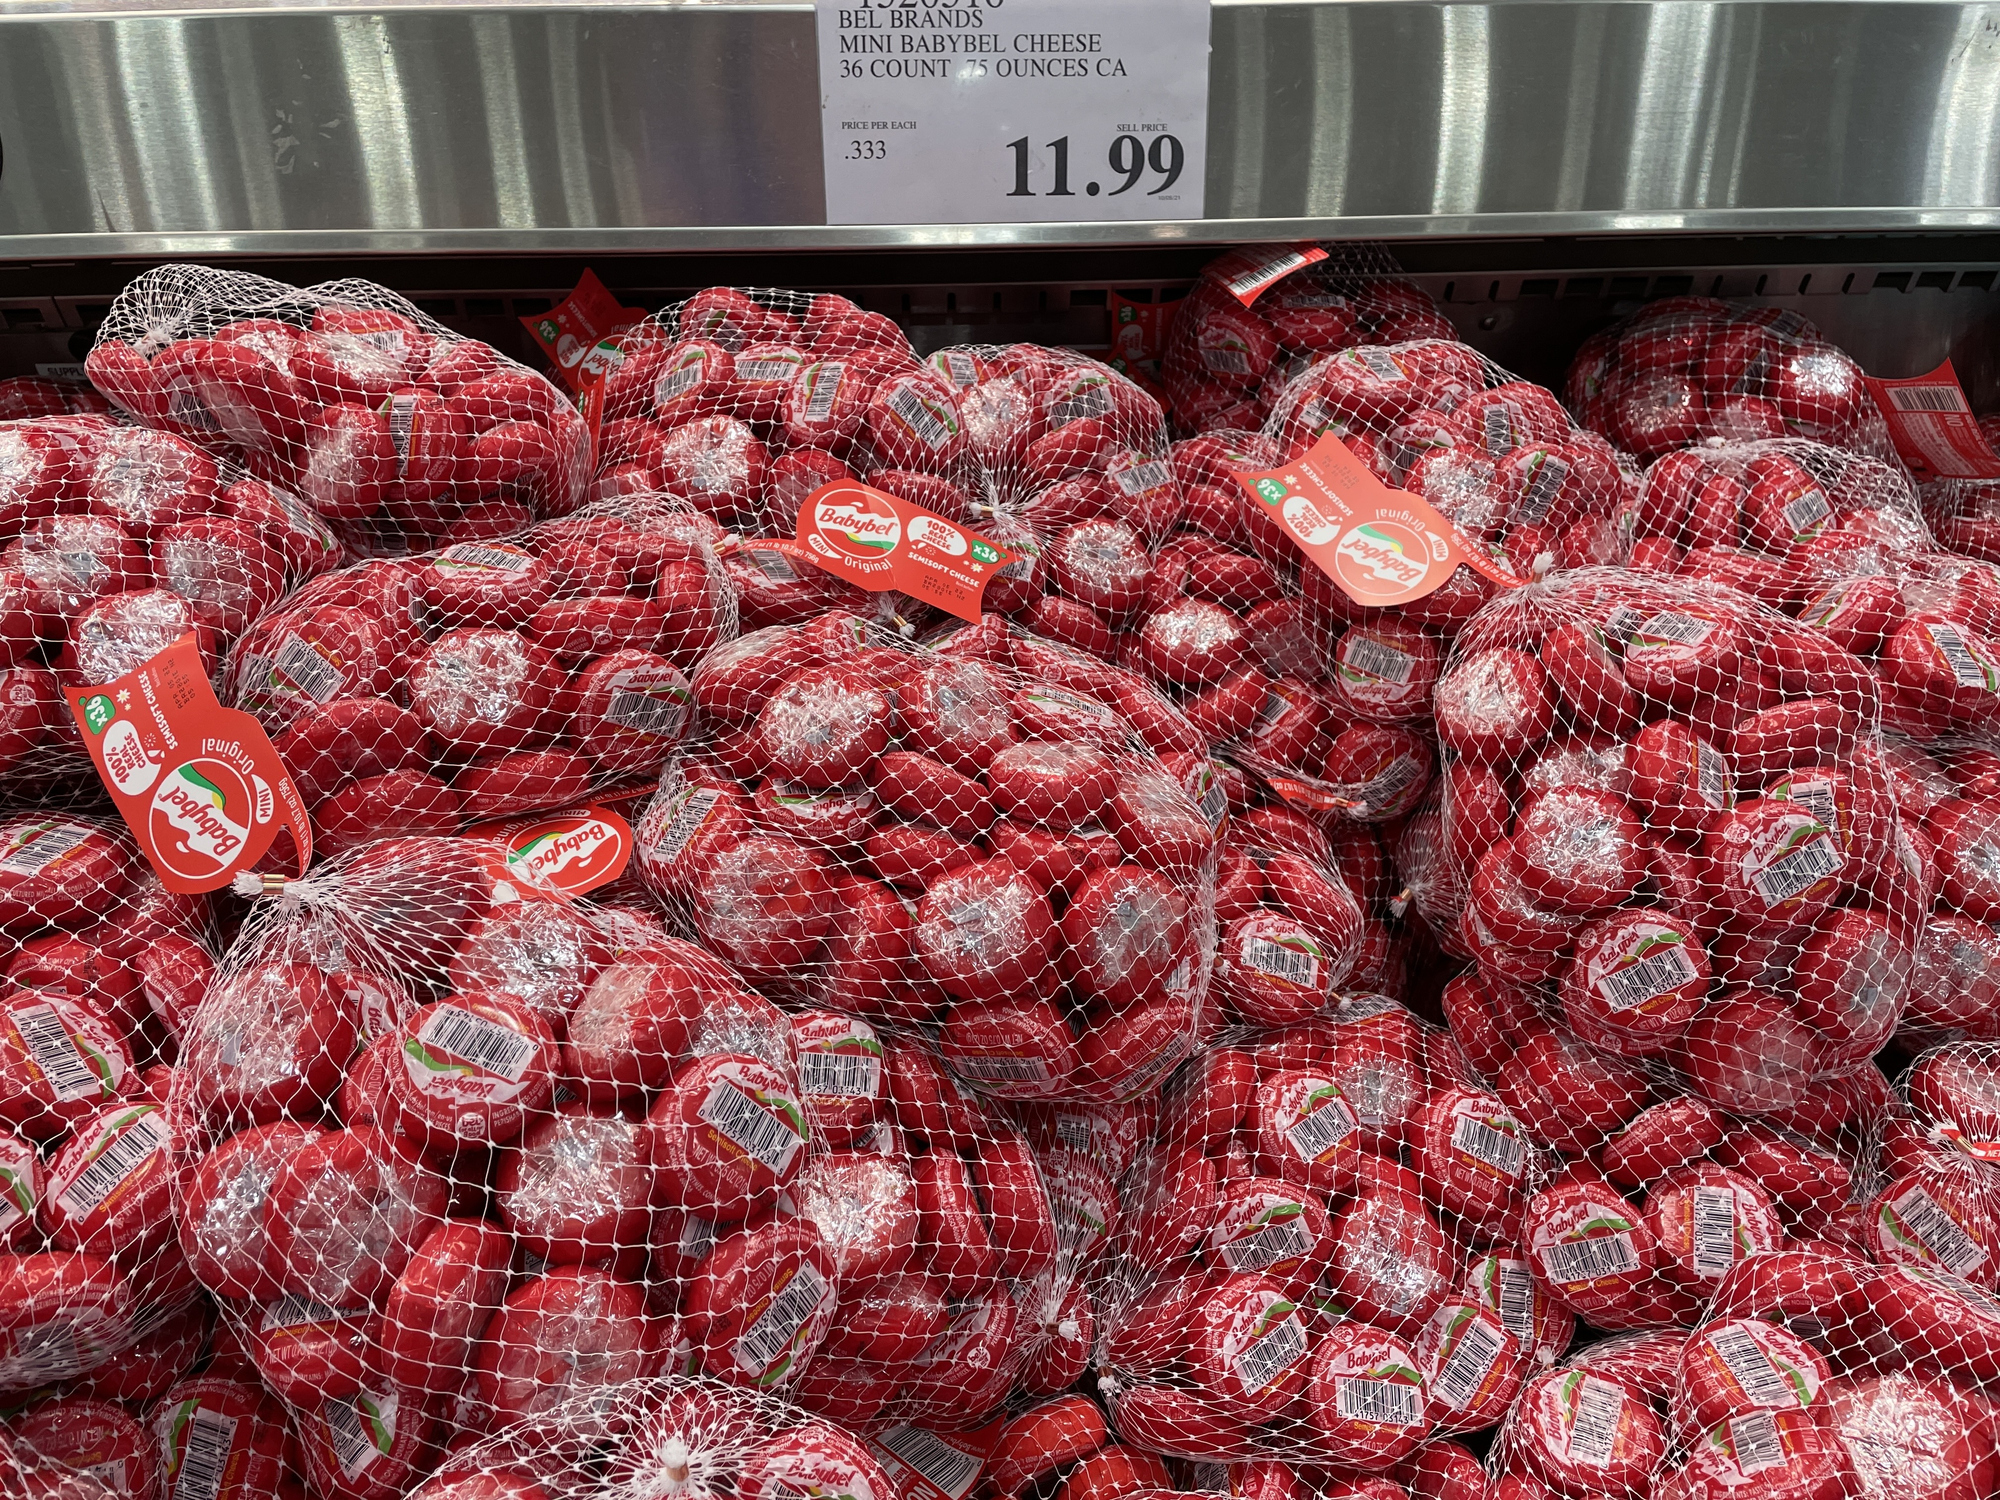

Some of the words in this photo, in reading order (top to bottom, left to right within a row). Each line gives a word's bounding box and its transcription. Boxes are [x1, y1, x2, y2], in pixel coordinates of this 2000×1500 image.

[839, 10, 882, 29] BEL
[890, 10, 983, 29] BRANDS
[840, 35, 891, 53] MINI
[900, 34, 1006, 53] BABYBEL
[1014, 34, 1102, 53] CHEESE
[841, 59, 863, 78] 36
[870, 59, 951, 78] COUNT
[996, 58, 1088, 77] OUNCES
[1096, 58, 1127, 77] CA
[841, 121, 868, 130] PRICE
[871, 122, 888, 130] PER
[891, 121, 917, 130] EACH
[1117, 124, 1138, 132] SELL
[1141, 123, 1167, 131] PRICE
[845, 140, 886, 160] .333
[1006, 134, 1184, 197] 11.99
[539, 321, 556, 341] x36
[47, 367, 84, 376] SUPPL
[1944, 414, 1964, 427] NO
[1299, 462, 1324, 487] CHEESE
[1258, 479, 1281, 500] x36
[1321, 485, 1354, 516] SEMISOFT
[818, 507, 895, 536] Babybel
[1287, 513, 1313, 537] 100%
[1300, 512, 1317, 529] REAL
[1302, 504, 1326, 528] CHEESE
[1375, 508, 1425, 532] Original
[926, 520, 956, 539] 100%
[928, 530, 948, 544] REAL
[781, 543, 794, 551] 10.7
[794, 548, 804, 556] oz)
[804, 552, 819, 563] 756g
[810, 536, 829, 556] MINI
[921, 533, 951, 551] CHEESE
[974, 544, 998, 563] x36
[1433, 538, 1446, 558] MINI
[1461, 543, 1471, 553] oz)
[844, 555, 893, 574] Original
[1342, 538, 1422, 583] Babybel
[1468, 551, 1482, 563] 10.7
[908, 551, 950, 576] SEMISOFT
[949, 569, 980, 588] CHEESE
[163, 667, 170, 676] 22
[138, 671, 156, 704] CHEESE
[87, 696, 108, 726] x36
[173, 693, 183, 709] APR
[150, 703, 178, 750] SEMISOFT
[120, 745, 136, 770] REAL
[124, 732, 146, 768] CHEESE
[202, 738, 255, 775] Original
[106, 746, 131, 784] 100%
[278, 777, 291, 800] 756g
[259, 788, 271, 818] MINI
[286, 795, 297, 810] oz)
[159, 786, 242, 857] Babybel
[291, 808, 302, 825] 10.7
[297, 823, 305, 833] lb
[1256, 962, 1278, 974] 41757
[1282, 972, 1303, 983] 3143
[1627, 990, 1652, 1006] 41757
[1655, 977, 1682, 994] 03143
[800, 1020, 851, 1043] Babybel
[739, 1065, 788, 1095] Babybel
[707, 1129, 736, 1155] Semisoft
[716, 1120, 744, 1143] 1757
[58, 1121, 105, 1181] Babybel
[98, 1180, 131, 1212] Semisoft
[1224, 1196, 1266, 1235] Babybel
[1547, 1204, 1590, 1239] Babybel
[1276, 1260, 1298, 1274] Cheese
[1596, 1277, 1620, 1287] Cheese
[747, 1298, 769, 1323] Cheese
[1347, 1346, 1392, 1369] Babybel
[1764, 1330, 1809, 1369] Babybel
[787, 1457, 856, 1488] Babybel
